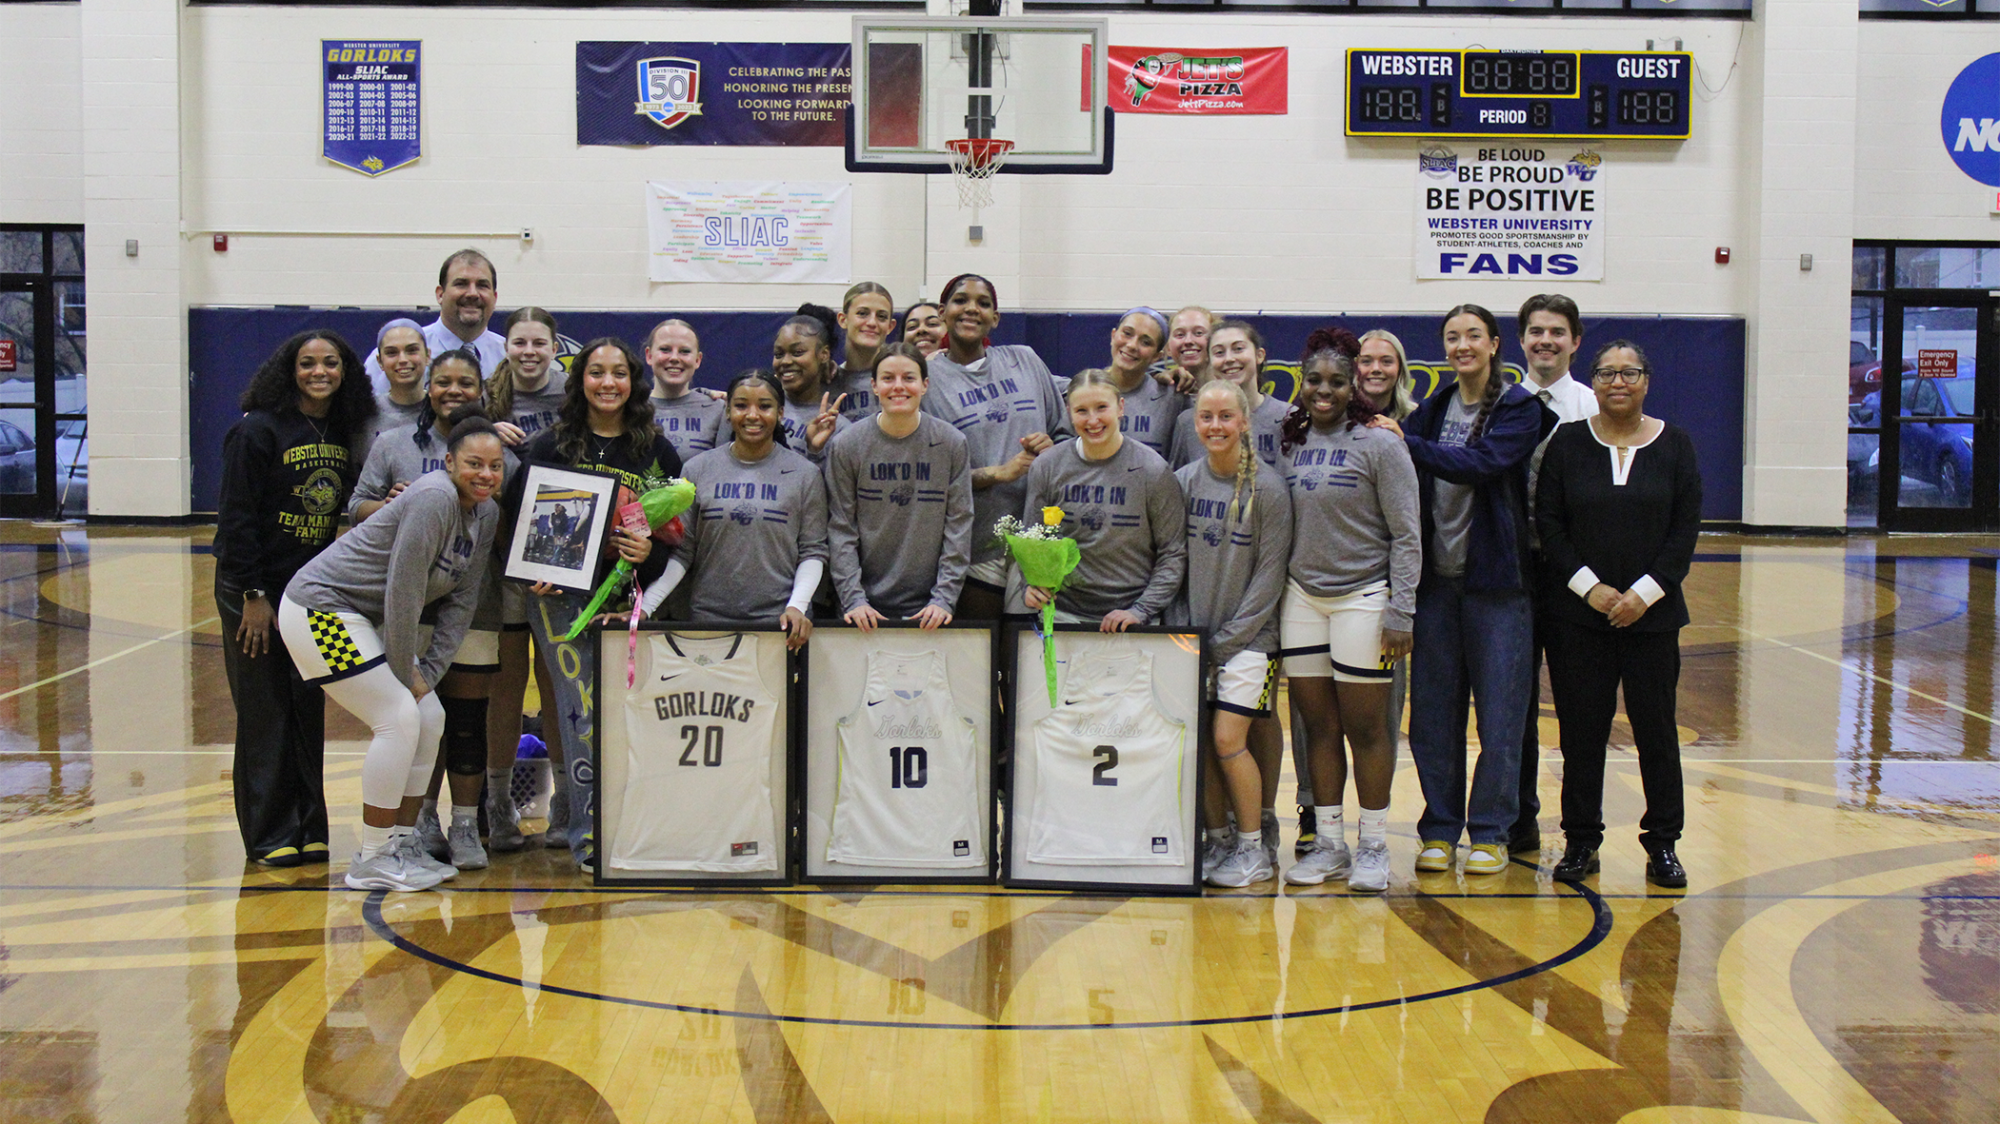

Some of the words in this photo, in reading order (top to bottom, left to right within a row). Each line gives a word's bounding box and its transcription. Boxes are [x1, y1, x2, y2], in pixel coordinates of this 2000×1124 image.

[328, 49, 416, 62] GORLOKS
[356, 66, 389, 74] SLIAC
[729, 67, 804, 77] CELEBRATING
[808, 68, 827, 77] THE
[831, 68, 851, 77] PAS
[1177, 56, 1244, 80] JET'S
[1362, 55, 1453, 76] WEBSTER
[1617, 58, 1681, 79] GUEST
[651, 75, 688, 100] 50
[724, 83, 789, 93] HONORING
[792, 84, 812, 93] THE
[816, 84, 852, 93] PRESEN
[1179, 82, 1243, 96] PIZZA
[738, 99, 791, 109] LOOKING
[796, 100, 851, 109] FORWARD
[752, 111, 767, 120] TO
[771, 111, 790, 120] THE
[794, 111, 836, 121] FUTURE.
[1479, 110, 1527, 124] PERIOD
[1478, 149, 1497, 162] BE
[1502, 149, 1545, 162] LOUD
[1458, 166, 1483, 182] BE
[1490, 167, 1564, 183] PROUD
[1426, 188, 1460, 210] BE
[1469, 189, 1594, 212] POSITIVE
[705, 217, 788, 246] SLIAC
[1428, 218, 1498, 230] WEBSTER
[1503, 219, 1593, 230] UNIVERSITY
[1437, 240, 1521, 249] STUDENT-ATHLETES,
[1440, 253, 1579, 275] FANS
[1920, 351, 1955, 359] Emergency
[833, 391, 869, 413] OK'D
[958, 383, 1000, 408] LOK'D
[1000, 378, 1018, 394] IN
[654, 418, 679, 431] K'D
[686, 418, 701, 432] IN
[1135, 415, 1150, 432] IN
[1258, 434, 1274, 451] IN
[283, 444, 319, 465] WEBSTER
[318, 444, 349, 462] UNIVER
[1294, 449, 1327, 467] LOK'D
[1329, 449, 1347, 466] IN
[870, 462, 911, 480] LOK'D
[916, 462, 930, 481] IN
[714, 482, 756, 499] LOK'D
[761, 484, 777, 500] IN
[1064, 485, 1104, 503] LOK'D
[1110, 486, 1126, 505] IN
[1189, 497, 1226, 520] LOK'D
[278, 511, 306, 526] TEAM
[307, 515, 338, 527] MANA
[295, 527, 330, 538] FAMIL
[654, 691, 754, 723] GORLOKS
[874, 715, 942, 740] Gorloks
[1072, 714, 1142, 738] Gorloks
[678, 725, 723, 767] 20
[890, 747, 927, 788] 10
[1092, 745, 1118, 786] 2
